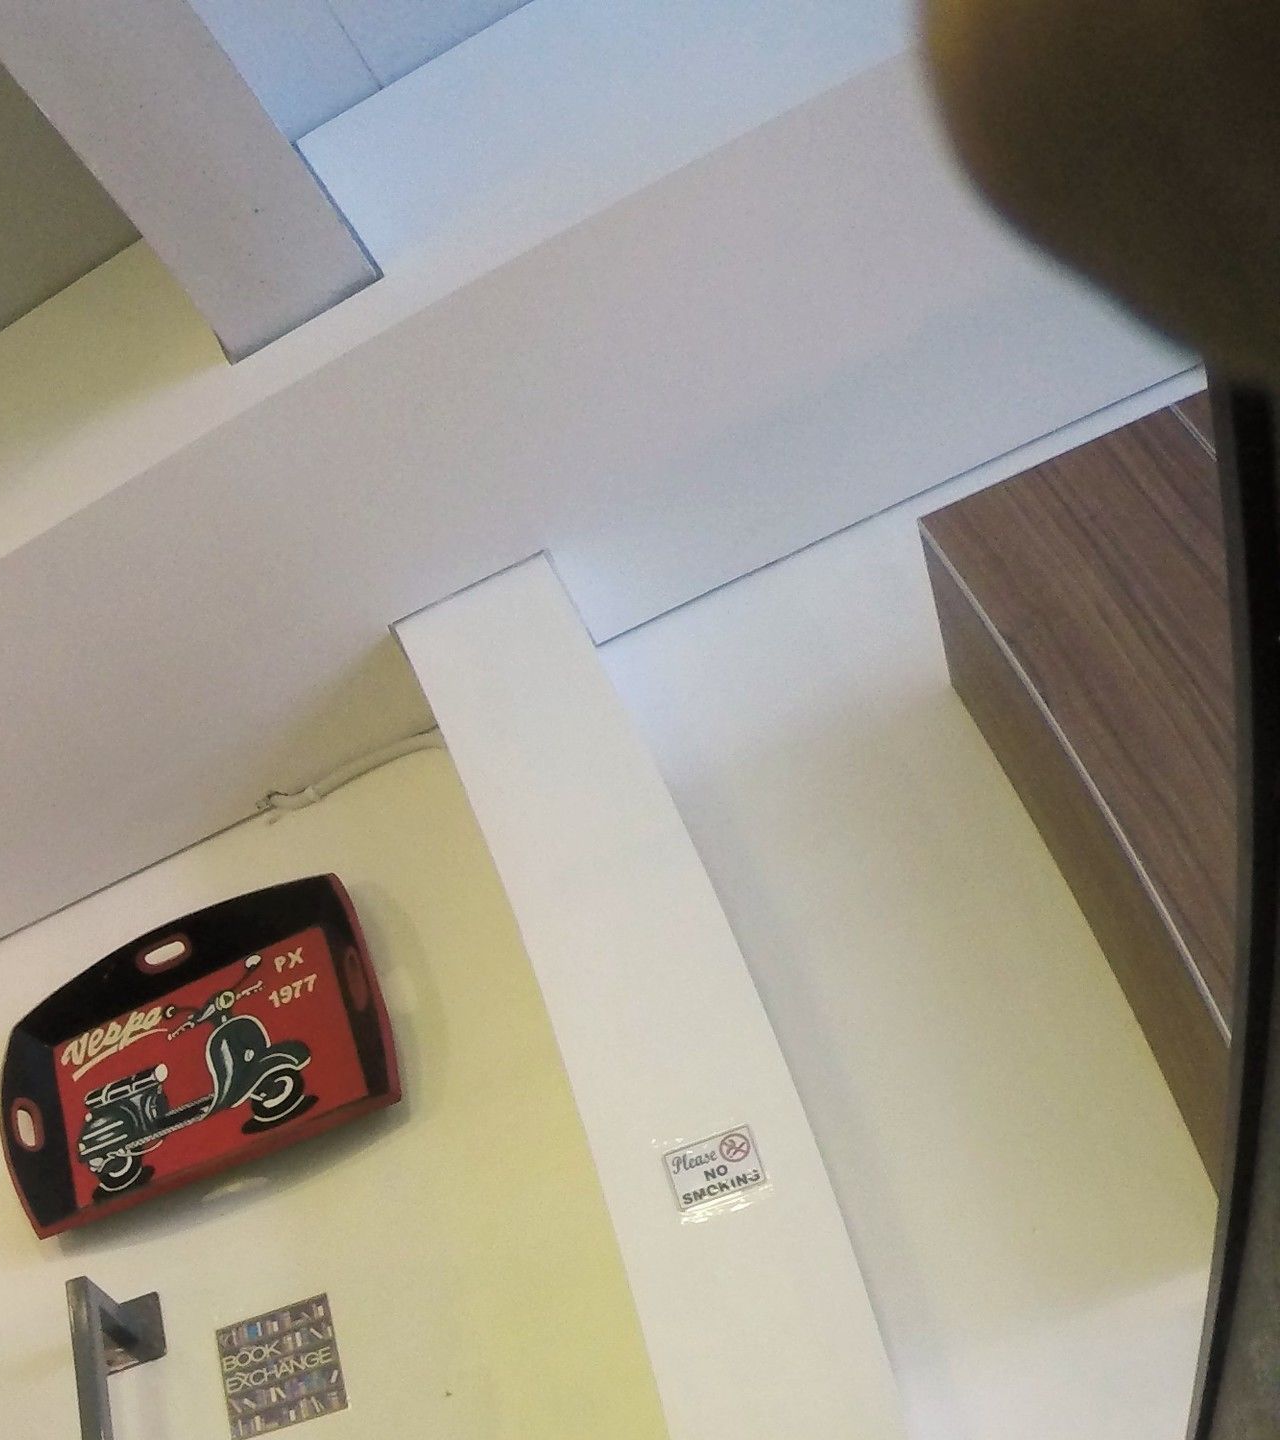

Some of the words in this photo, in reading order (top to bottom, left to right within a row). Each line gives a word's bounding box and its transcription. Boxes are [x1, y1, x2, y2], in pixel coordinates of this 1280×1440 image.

[274, 946, 305, 974] PX
[267, 973, 318, 1008] 1977
[60, 1006, 167, 1080] Vespa
[671, 1150, 718, 1175] Please
[703, 1164, 728, 1181] NO
[222, 1340, 282, 1371] BOOK
[226, 1346, 334, 1394] EXCHANGE
